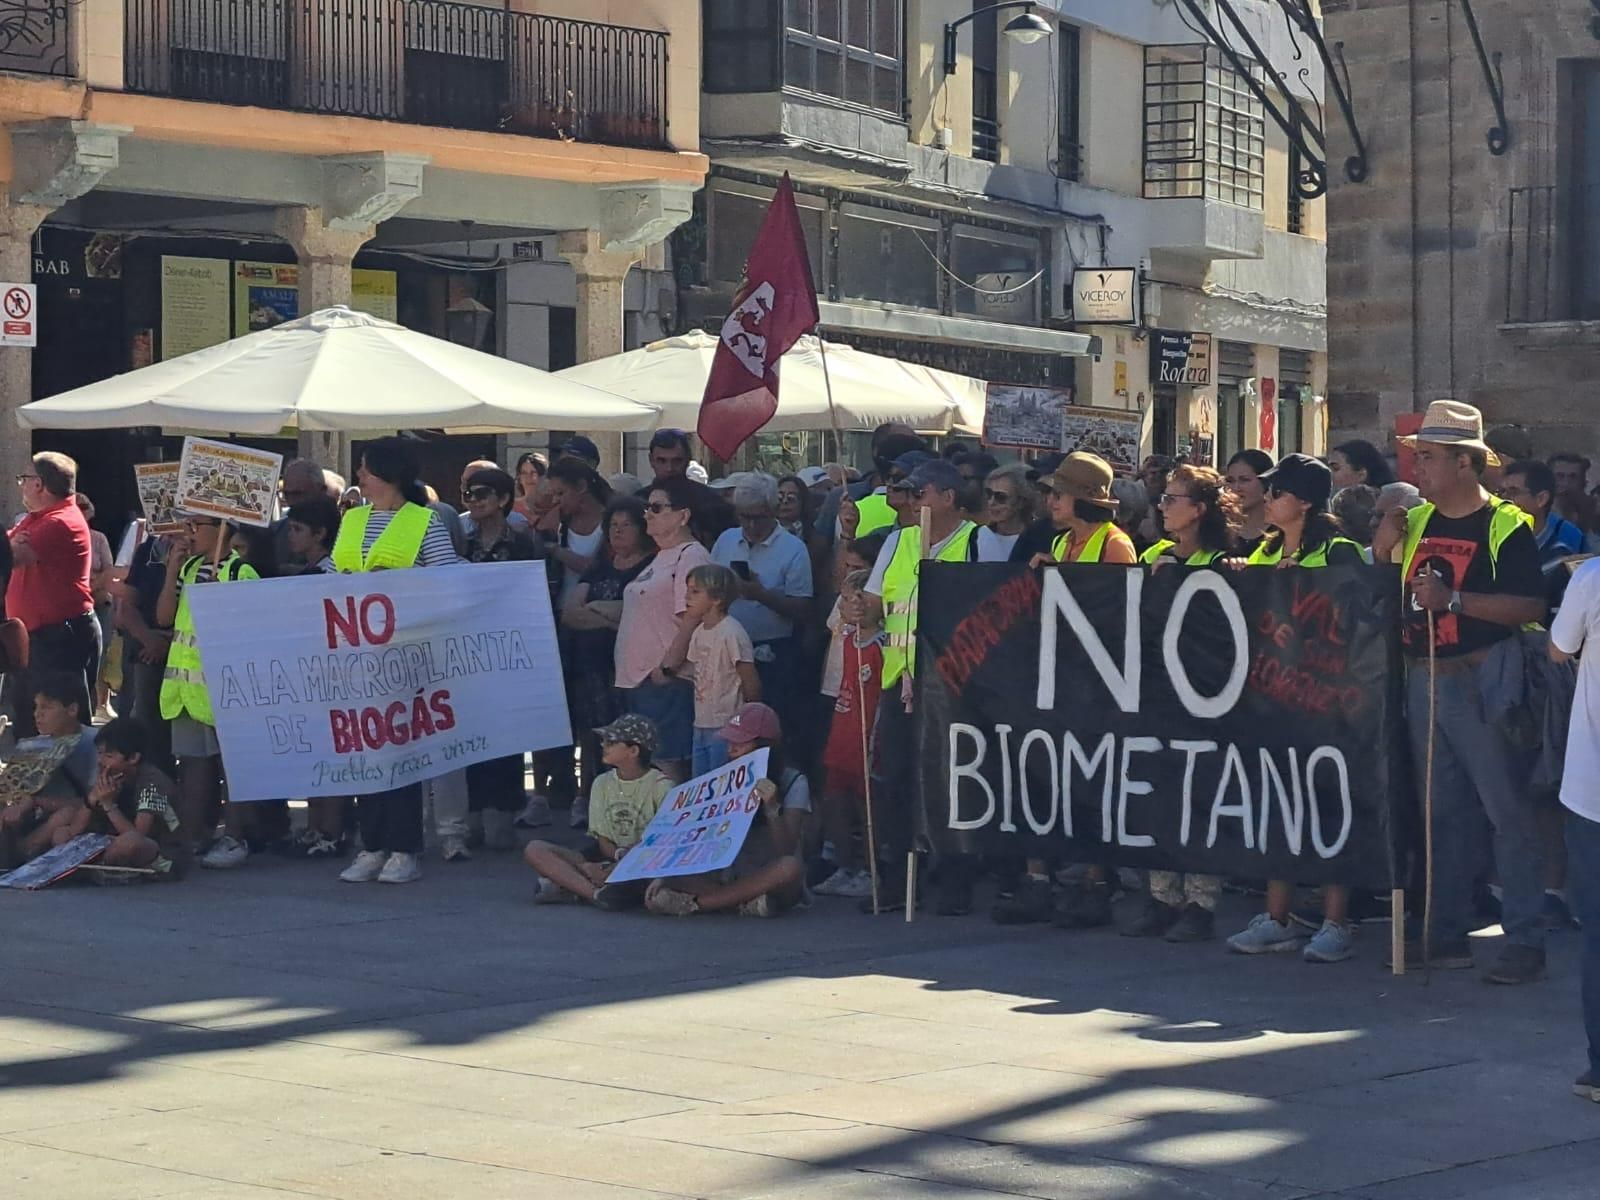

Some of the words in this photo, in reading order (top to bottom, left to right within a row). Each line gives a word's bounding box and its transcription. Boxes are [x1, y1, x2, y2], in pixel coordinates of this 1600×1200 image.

[1080, 290, 1127, 302] VICEROY
[1160, 360, 1209, 383] Rodera
[323, 593, 396, 649] NO
[1036, 567, 1249, 718] NO
[220, 665, 249, 709] A
[247, 659, 300, 706] LA
[300, 630, 534, 703] MACROPLANTA
[265, 714, 312, 755] DE
[329, 687, 456, 754] BIOGÁS
[311, 753, 384, 787] Pueblos
[390, 753, 432, 788] para
[442, 733, 489, 761] vivir
[672, 760, 756, 811] NUESTROS
[947, 722, 1352, 859] BIOMETANO
